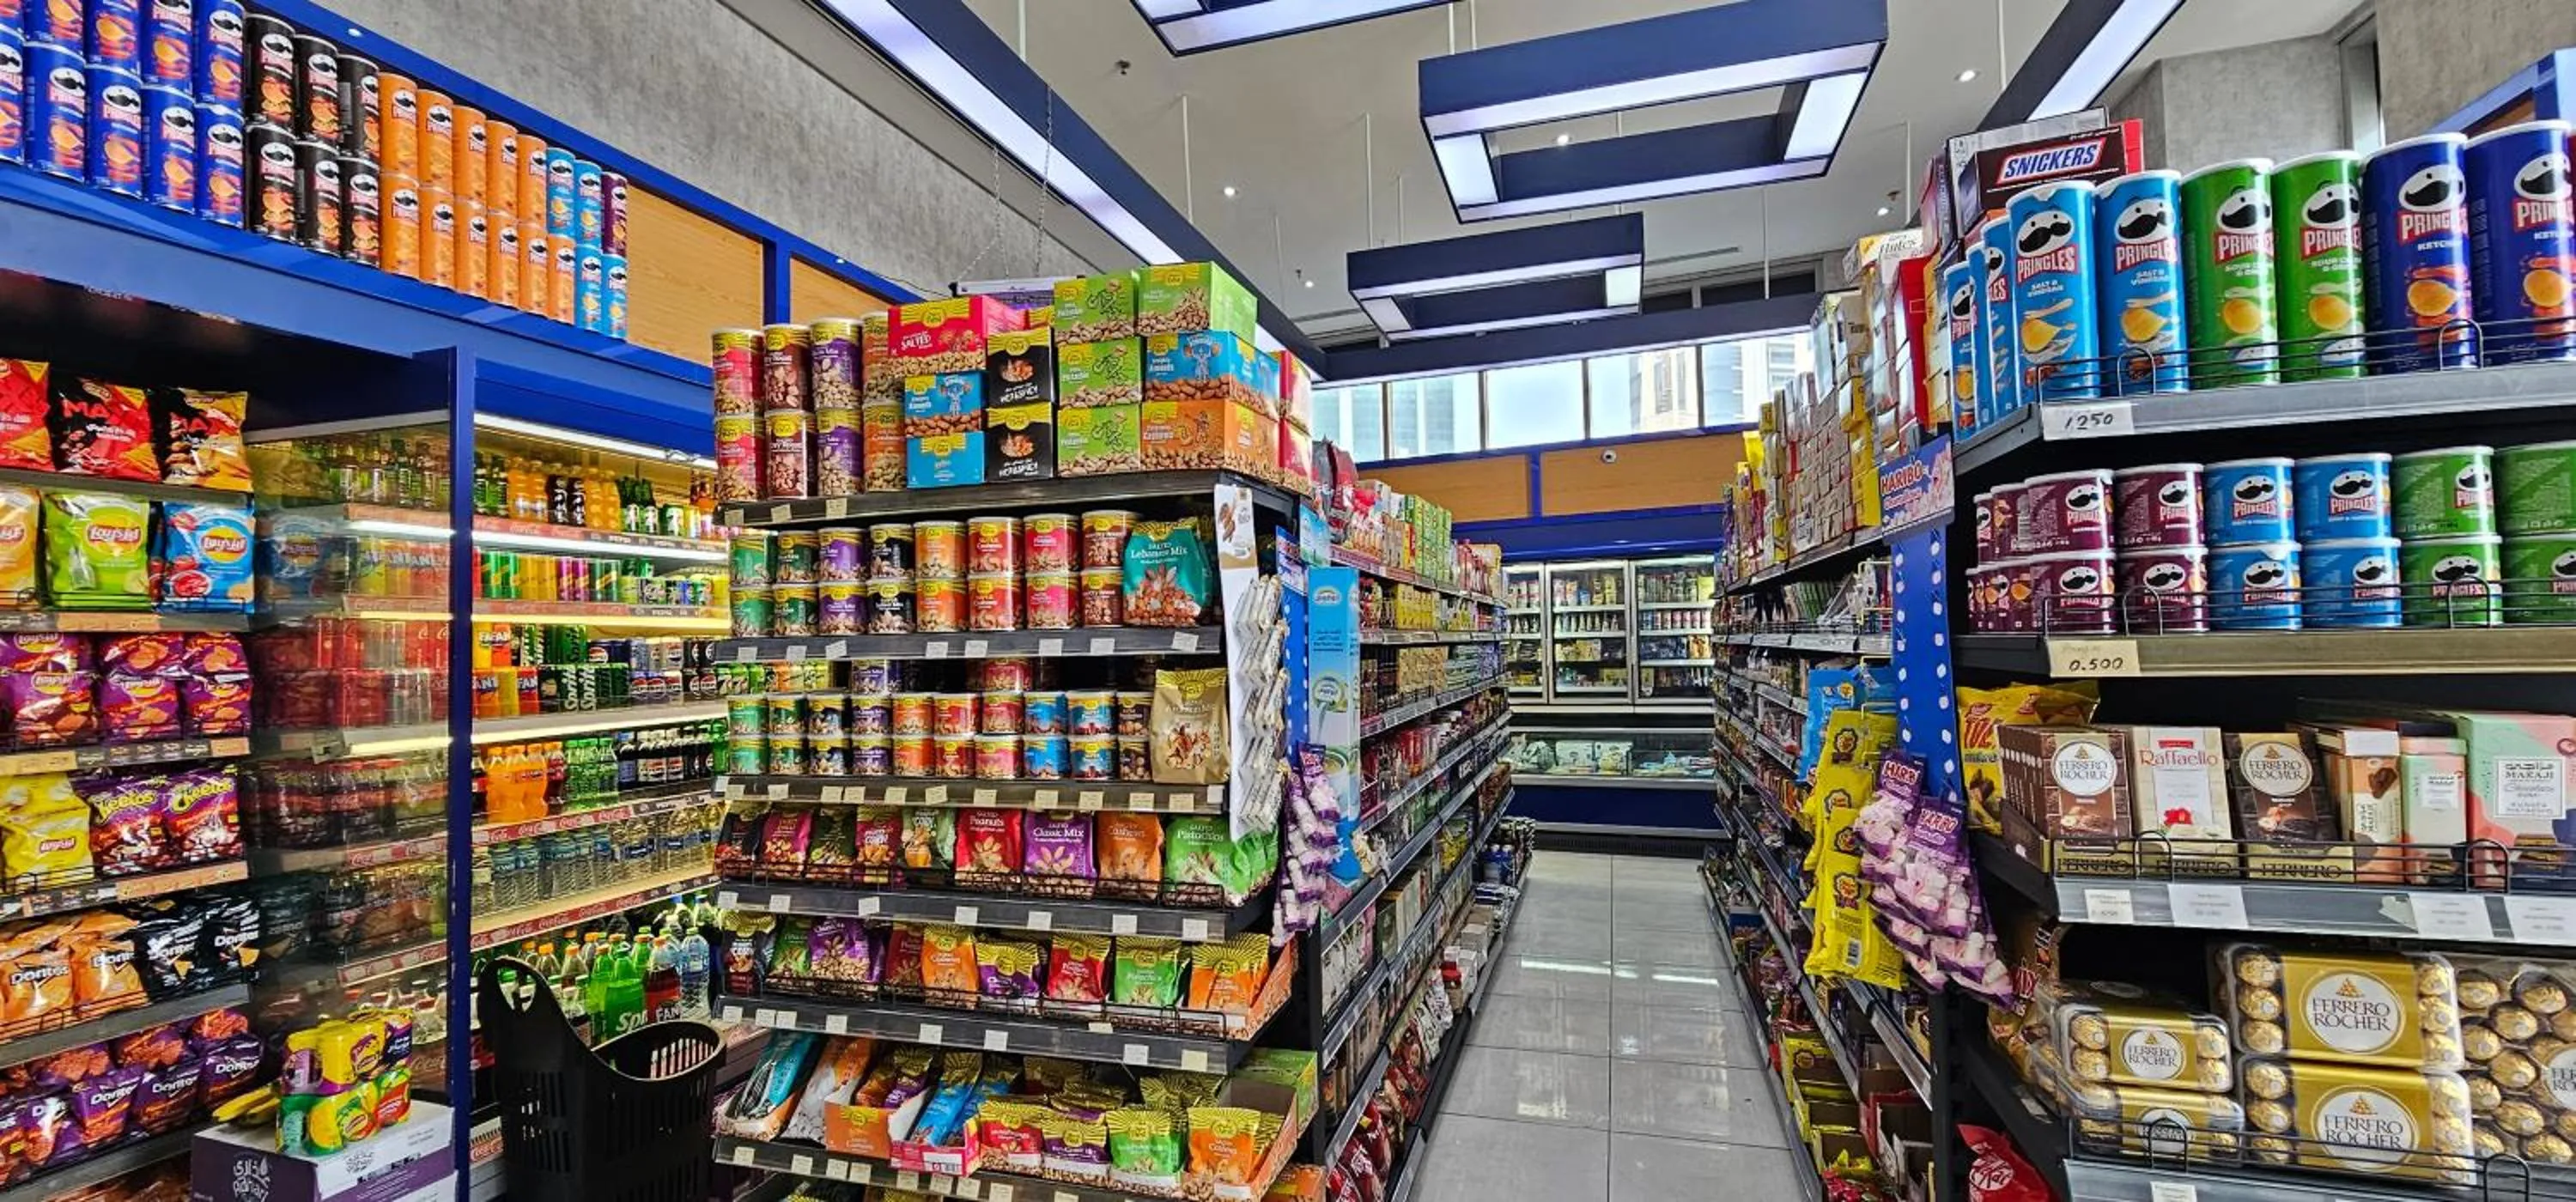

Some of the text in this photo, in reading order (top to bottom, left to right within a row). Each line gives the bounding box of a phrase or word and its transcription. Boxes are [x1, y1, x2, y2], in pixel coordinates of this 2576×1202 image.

[2004, 144, 2098, 178] SNICKERS
[2019, 246, 2075, 282] PRINGLES
[1880, 460, 1923, 495] HARIBO
[2069, 658, 2123, 671] 0.500
[2139, 749, 2218, 767] Raffaello
[2249, 760, 2302, 771] FERRERO
[172, 777, 233, 813] Cheetos
[1064, 828, 1084, 837] Mix
[12, 966, 69, 985] Doritos
[2312, 998, 2391, 1017] FERRERO
[2313, 1012, 2391, 1031] ROCHER
[2129, 1044, 2178, 1057] FERRERO
[2129, 1053, 2178, 1066] ROCHER
[2324, 1114, 2403, 1134] FERRERO
[2325, 1129, 2403, 1149] ROCHER
